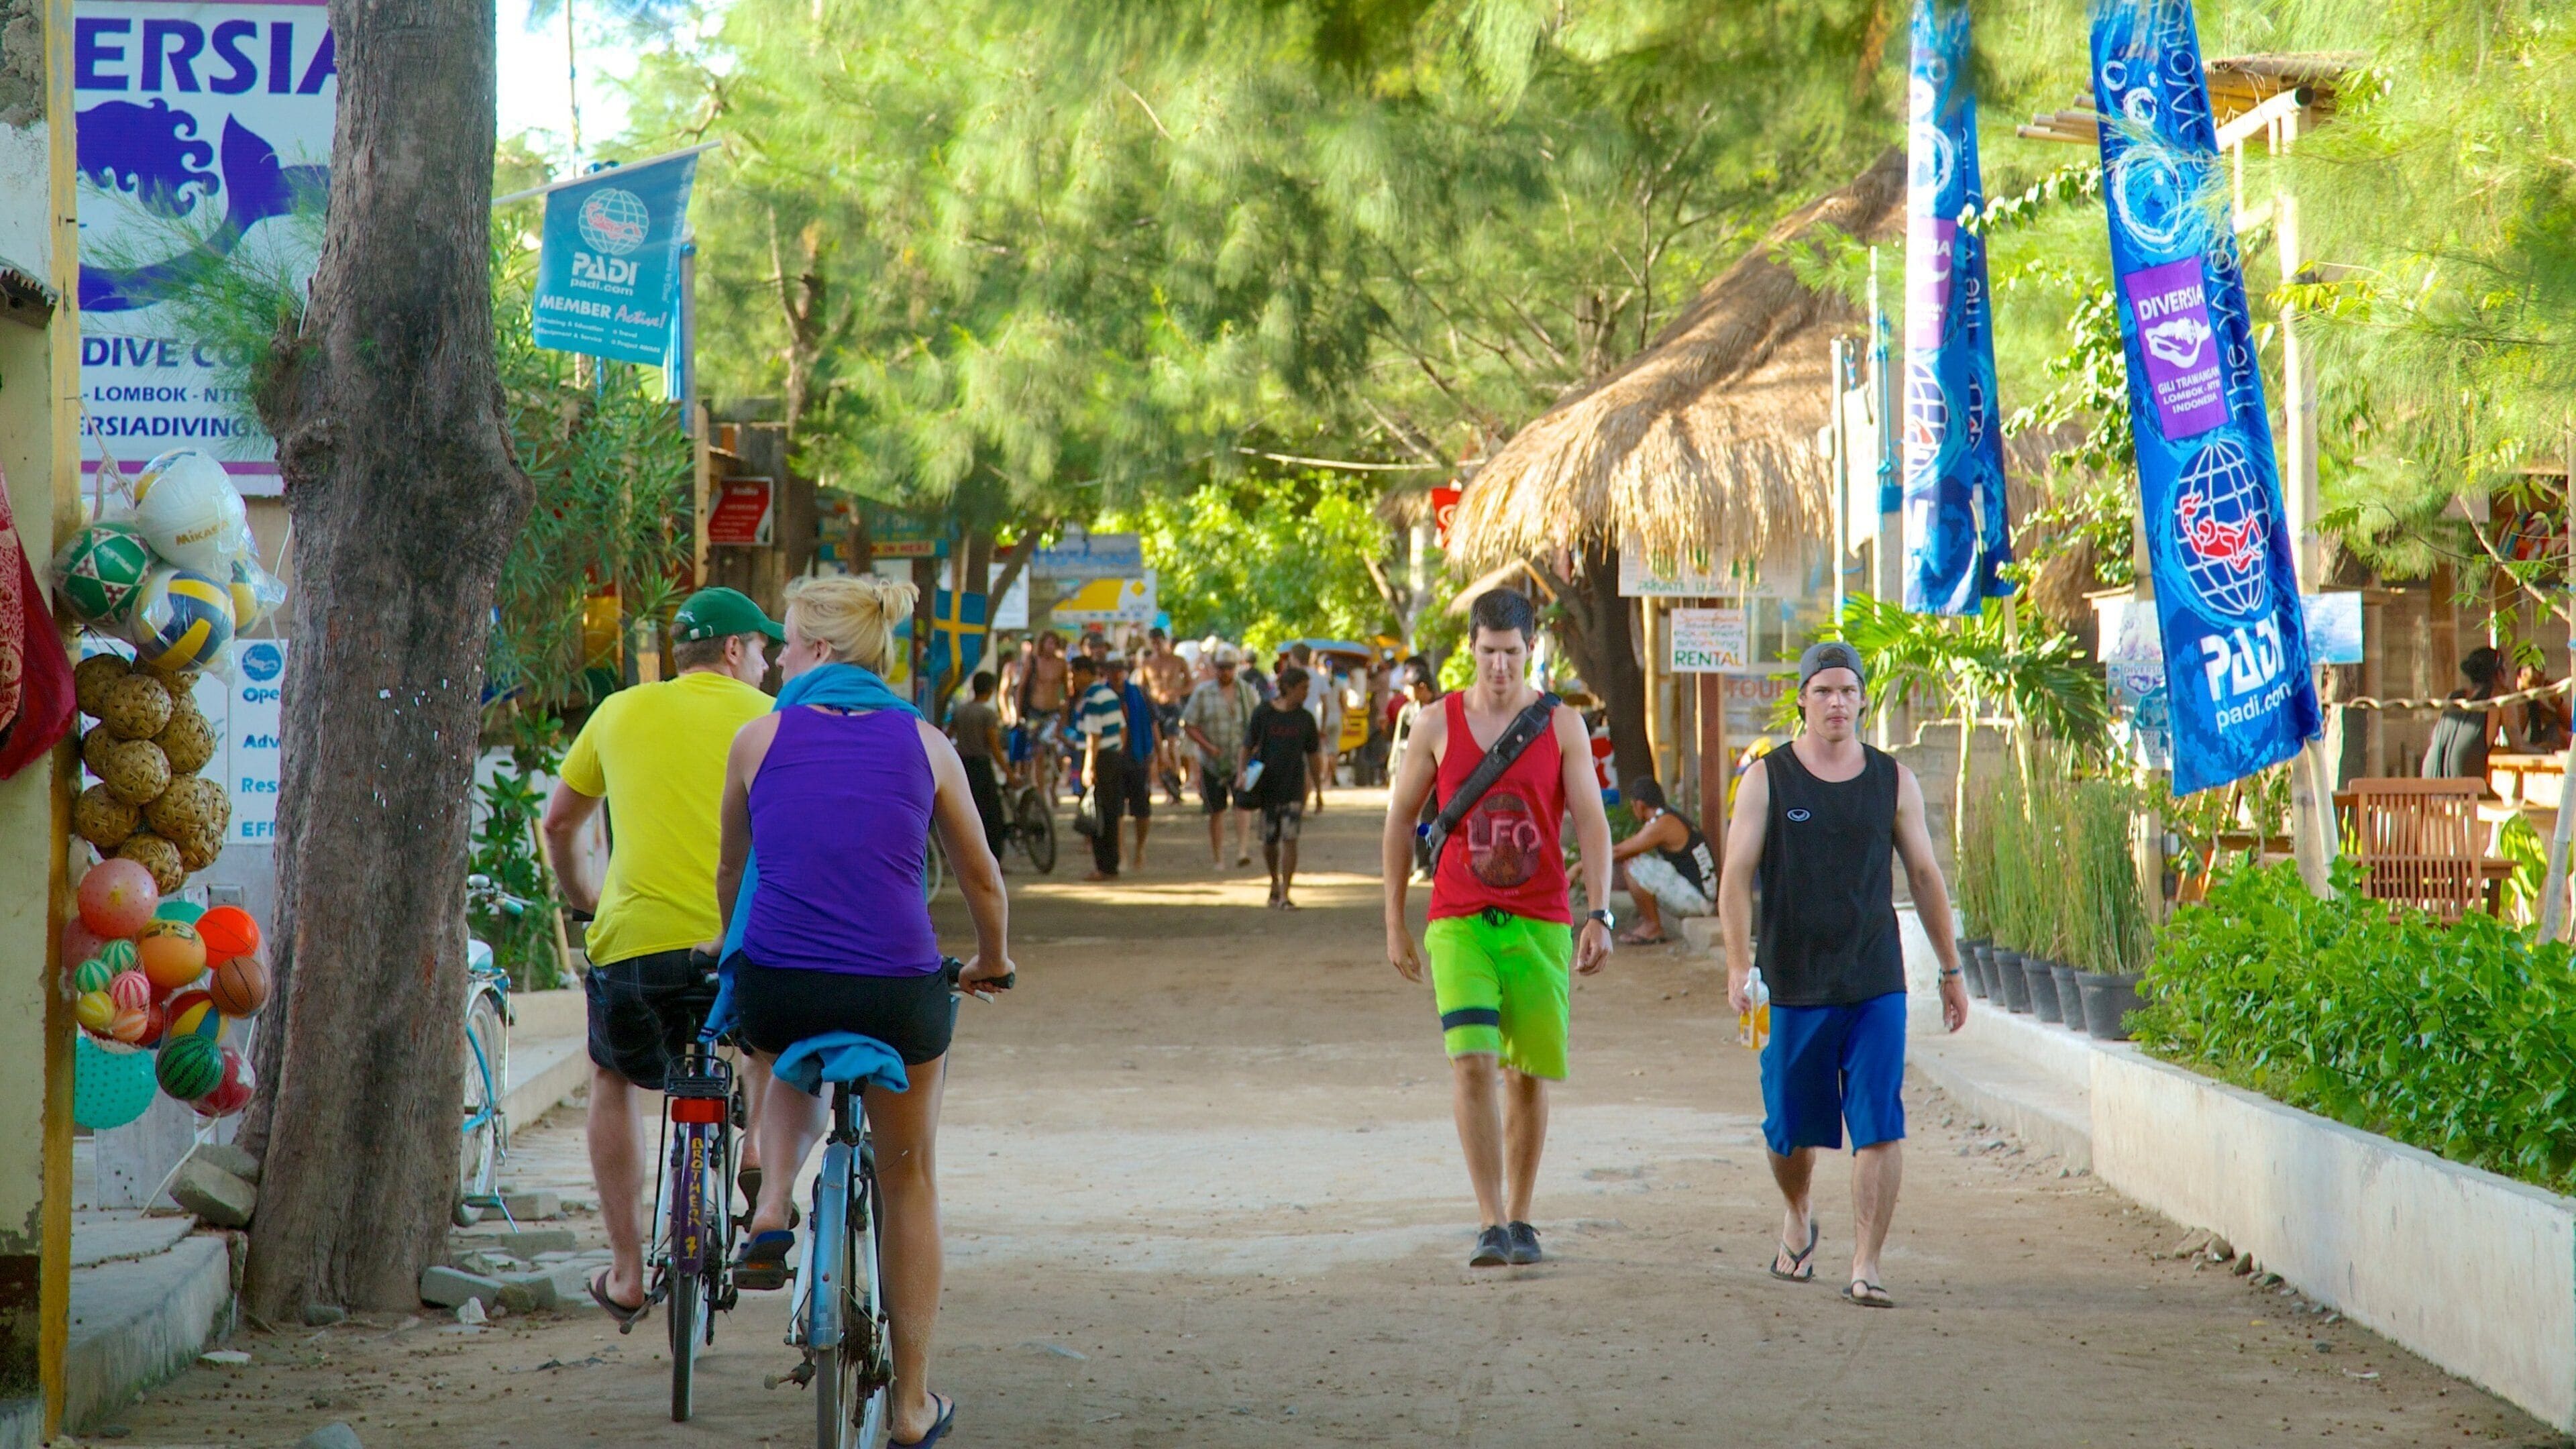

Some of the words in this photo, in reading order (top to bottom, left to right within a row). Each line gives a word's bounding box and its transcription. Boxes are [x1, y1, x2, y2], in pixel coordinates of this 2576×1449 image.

[572, 252, 637, 286] PADI
[570, 278, 633, 297] padi.com
[539, 294, 612, 319] MEMBER
[2138, 283, 2206, 321] DIVERSIA
[82, 337, 179, 367] DIVE
[2157, 380, 2176, 395] GILI
[2176, 365, 2220, 390] TRAWANGAN
[2226, 343, 2256, 421] The
[95, 386, 186, 402] LOMBOK
[2163, 385, 2204, 406] LOMBOK
[2172, 392, 2218, 415] INDONESIA
[1674, 650, 1743, 667] RENTAL
[2201, 610, 2285, 702] PADI
[241, 777, 280, 793] Res
[688, 1137, 704, 1227] BROTHER
